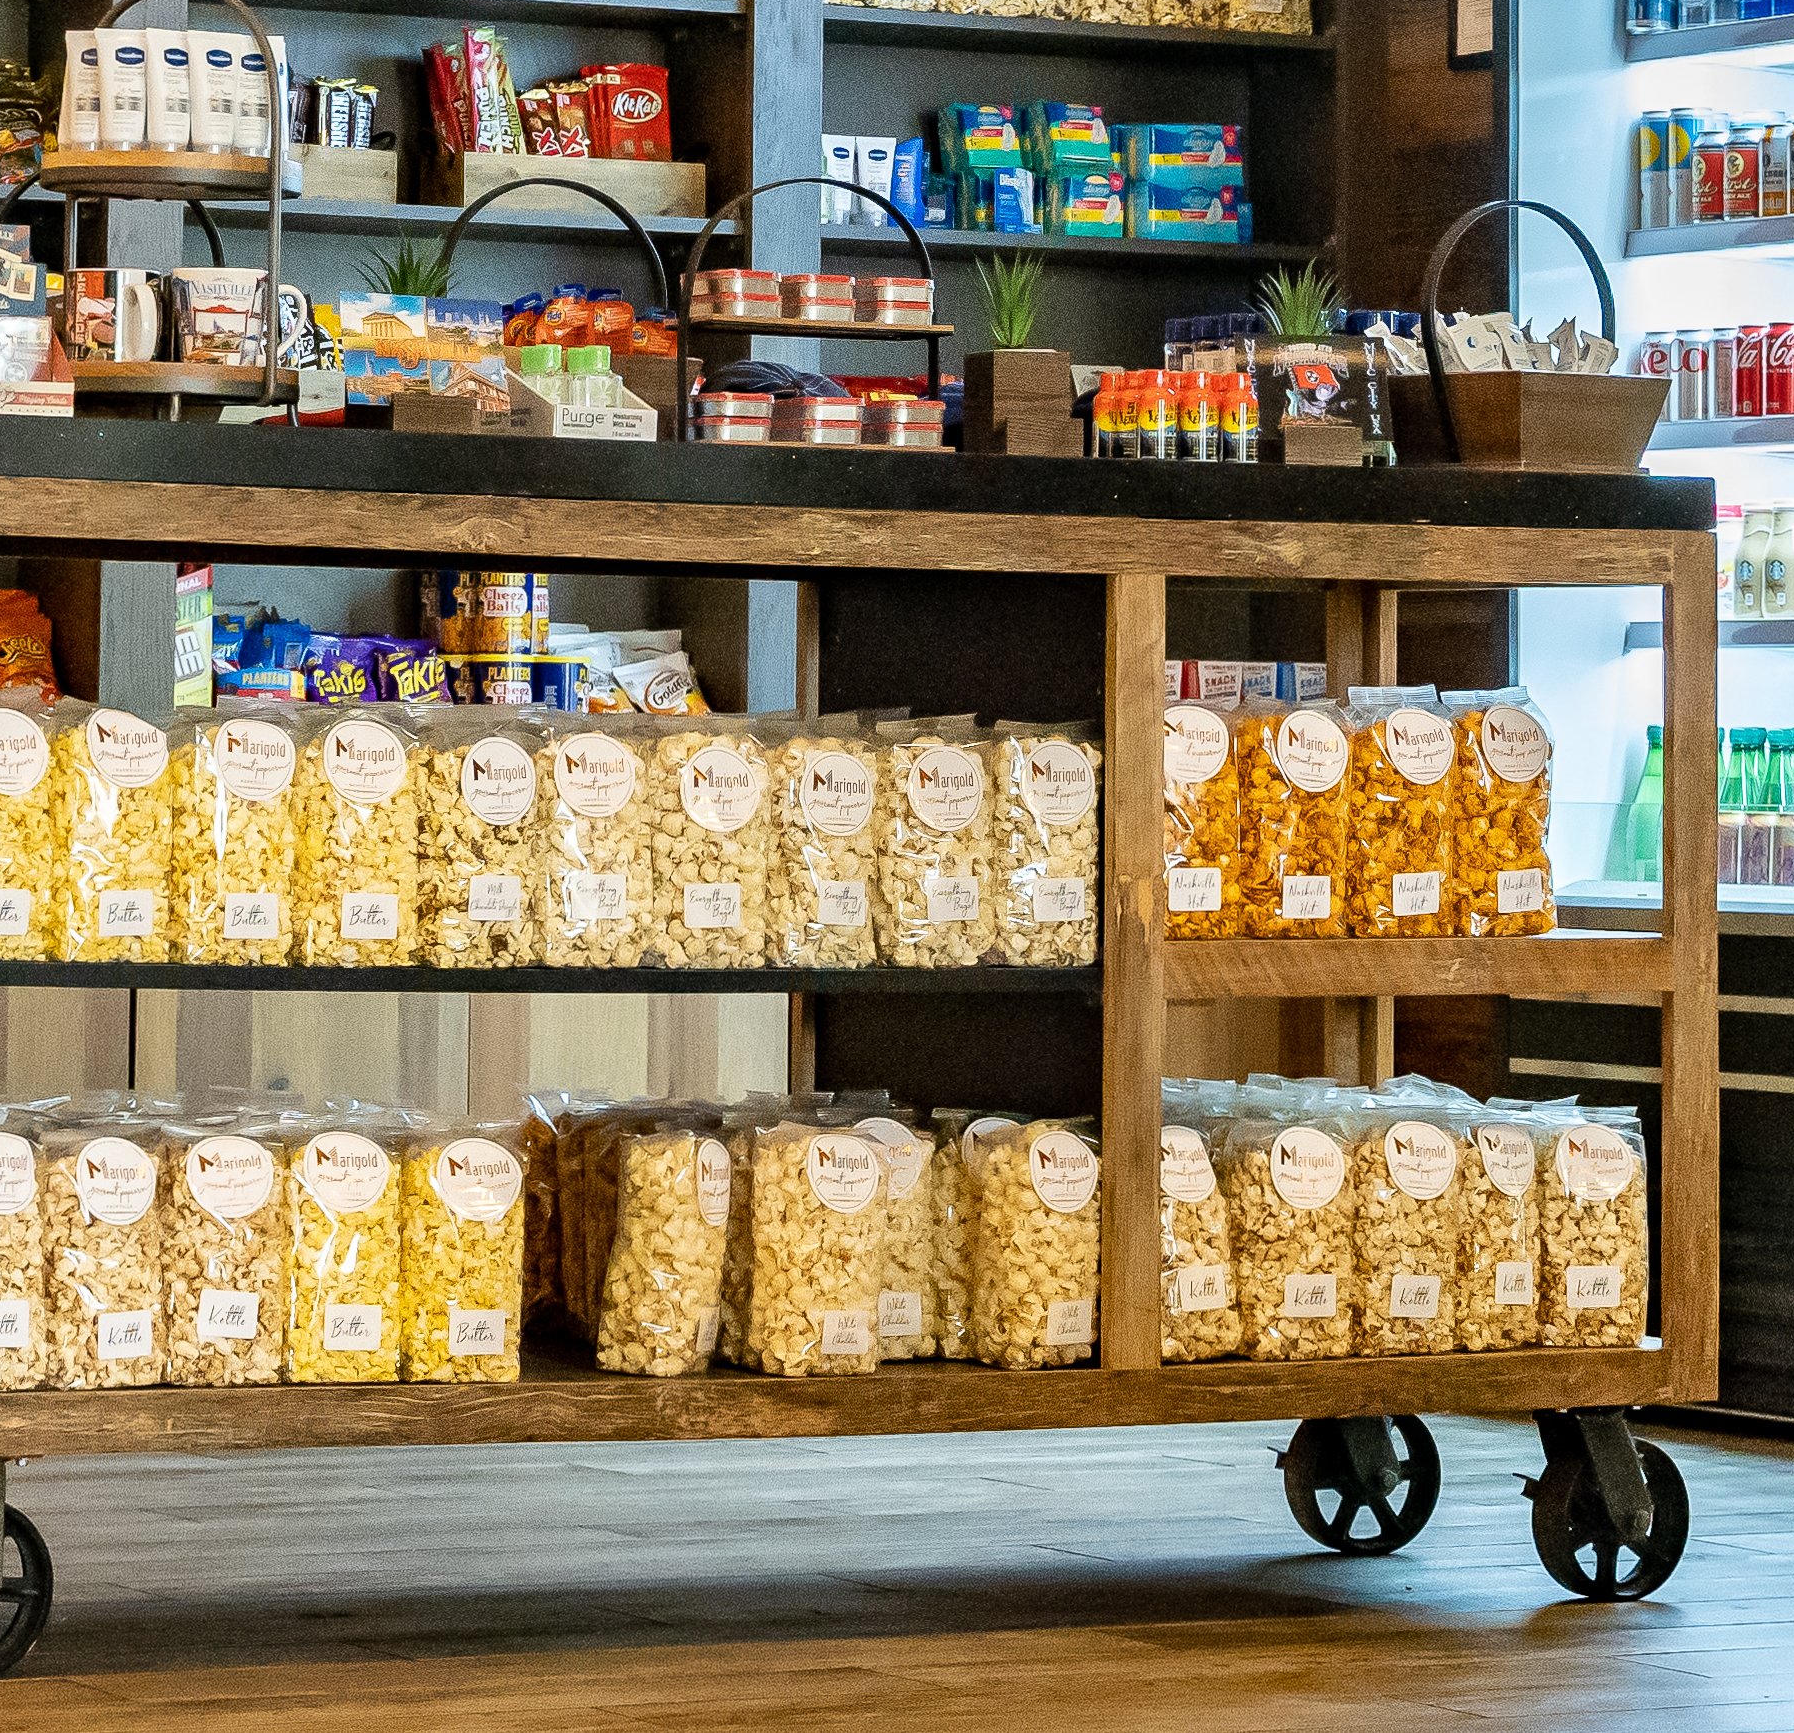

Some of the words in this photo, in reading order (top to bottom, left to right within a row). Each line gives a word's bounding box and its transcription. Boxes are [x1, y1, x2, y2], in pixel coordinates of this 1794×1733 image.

[331, 92, 349, 148] HERSHE
[191, 280, 253, 296] NASHVILLE
[562, 408, 604, 427] Purge
[483, 587, 524, 602] Cheez
[486, 600, 521, 613] Balls
[242, 672, 289, 685] PLANTERS
[314, 666, 366, 697] Takis
[390, 657, 445, 699] Takis
[1205, 675, 1236, 687] SNACK
[492, 682, 530, 696] Cheez
[96, 720, 158, 747] Marigold
[1392, 722, 1445, 749] Marigold
[226, 730, 286, 759] Marigold
[334, 735, 396, 764] Marigold
[472, 758, 527, 783] Marigold
[565, 751, 625, 775] Marigold
[1031, 759, 1087, 786] Marigold
[812, 768, 867, 796] Marigold
[918, 765, 975, 792] Marigold
[576, 880, 617, 898] Everything
[1173, 873, 1216, 891] Nashville
[1287, 882, 1326, 898] Nashville
[1397, 877, 1435, 895] Nashville
[1500, 873, 1539, 892] Nashville
[597, 894, 621, 910] Bagel
[689, 889, 732, 909] Everything
[823, 887, 859, 907] Everything
[931, 885, 971, 905] Everything
[1038, 887, 1076, 906] Everything
[1188, 892, 1207, 909] Hot
[1410, 894, 1430, 912] Hot
[1515, 892, 1534, 909] Hot
[106, 902, 146, 925] Butter
[231, 905, 271, 928] Butter
[348, 905, 390, 927] Butter
[712, 904, 736, 925] Bagel
[842, 902, 861, 920] Bagel
[952, 898, 976, 916] Bagel
[1059, 898, 1081, 917] Bagel
[1299, 900, 1318, 916] Hot
[817, 1146, 869, 1171] Marigold
[1037, 1147, 1089, 1170] Marigold
[1394, 1136, 1447, 1160] Marigold
[1568, 1136, 1623, 1162] Marigold
[315, 1146, 379, 1172] Marigold
[447, 1154, 511, 1179] Marigold
[1189, 1277, 1219, 1300] Kettle
[1502, 1276, 1528, 1294] Kettle
[1576, 1277, 1611, 1298] Kettle
[1293, 1286, 1328, 1308] Kettle
[1399, 1287, 1431, 1308] Kettle
[209, 1302, 245, 1329] Kettle
[108, 1322, 144, 1348] Kettle
[329, 1314, 372, 1340] Butter
[456, 1319, 499, 1345] Butter
